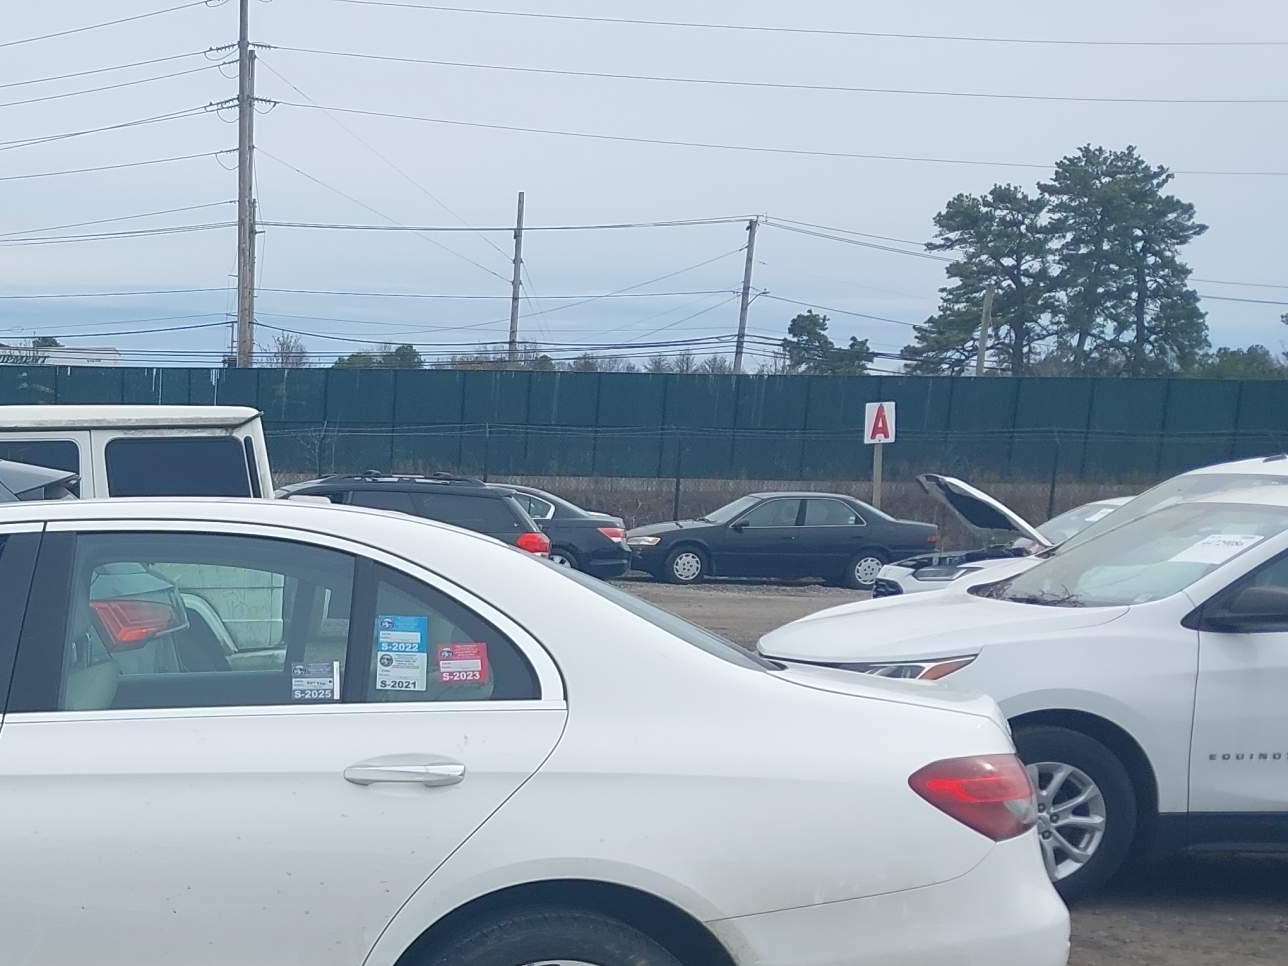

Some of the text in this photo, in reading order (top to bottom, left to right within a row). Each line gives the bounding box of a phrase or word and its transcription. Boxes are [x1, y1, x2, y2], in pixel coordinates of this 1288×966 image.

[871, 403, 890, 440] A
[381, 643, 419, 652] S-2022
[442, 671, 481, 681] S-2023
[380, 680, 417, 689] S-2021
[294, 689, 332, 699] S-2025
[1209, 752, 1288, 761] EQUINO
